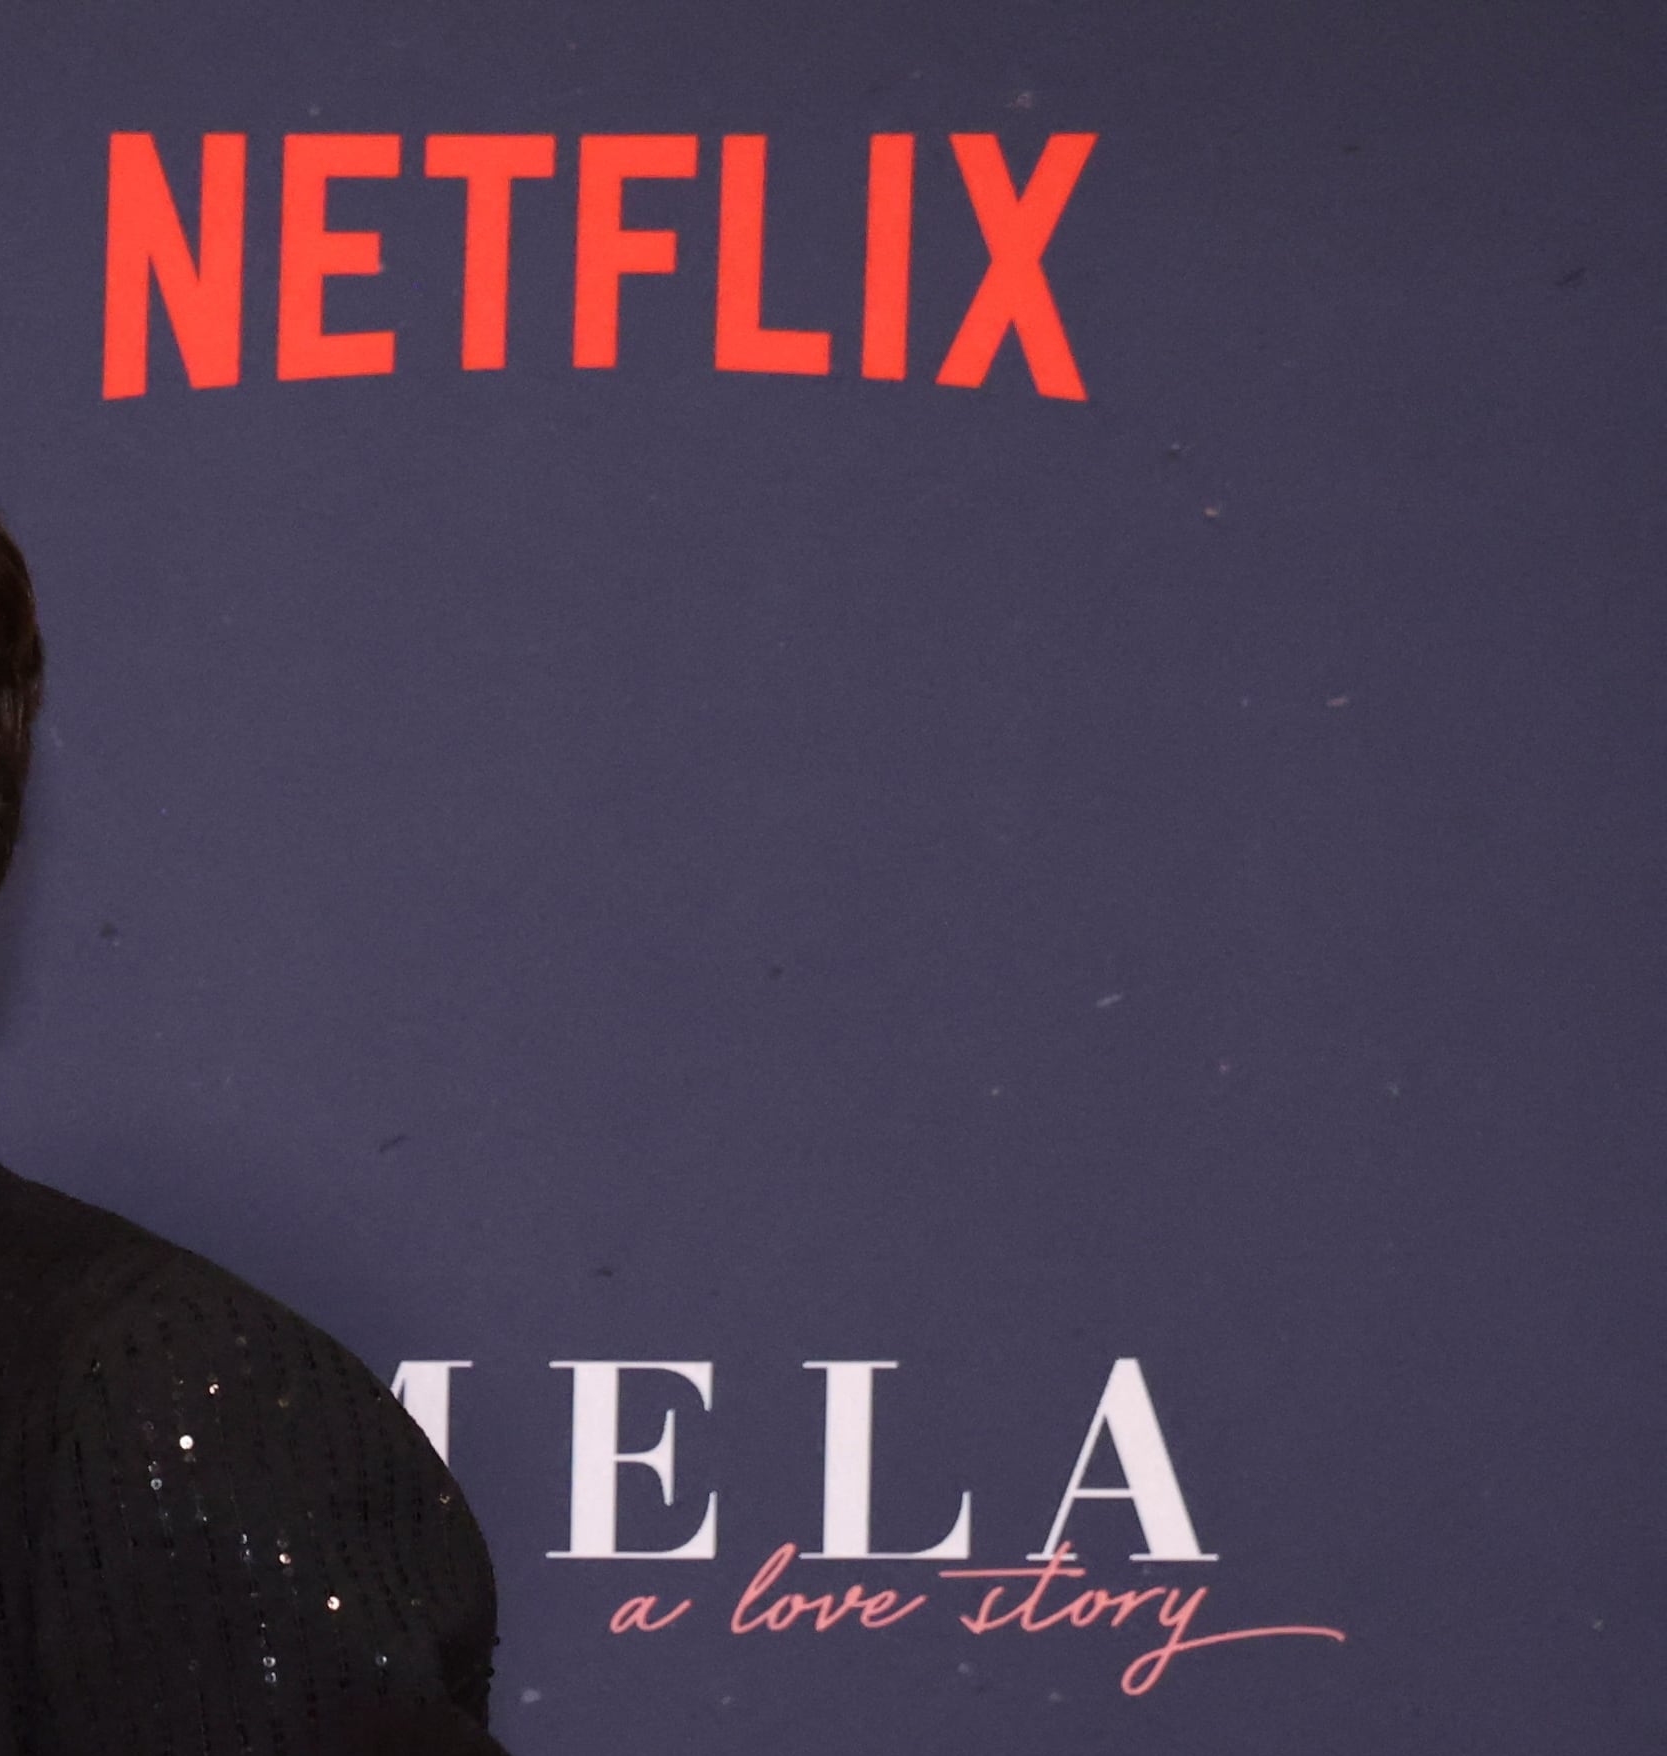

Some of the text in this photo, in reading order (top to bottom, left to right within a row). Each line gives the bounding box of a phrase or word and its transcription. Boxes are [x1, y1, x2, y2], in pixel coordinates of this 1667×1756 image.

[102, 131, 1098, 401] NETFLIX
[390, 1357, 1219, 1562] ELA
[609, 1540, 1346, 1696] a love story
